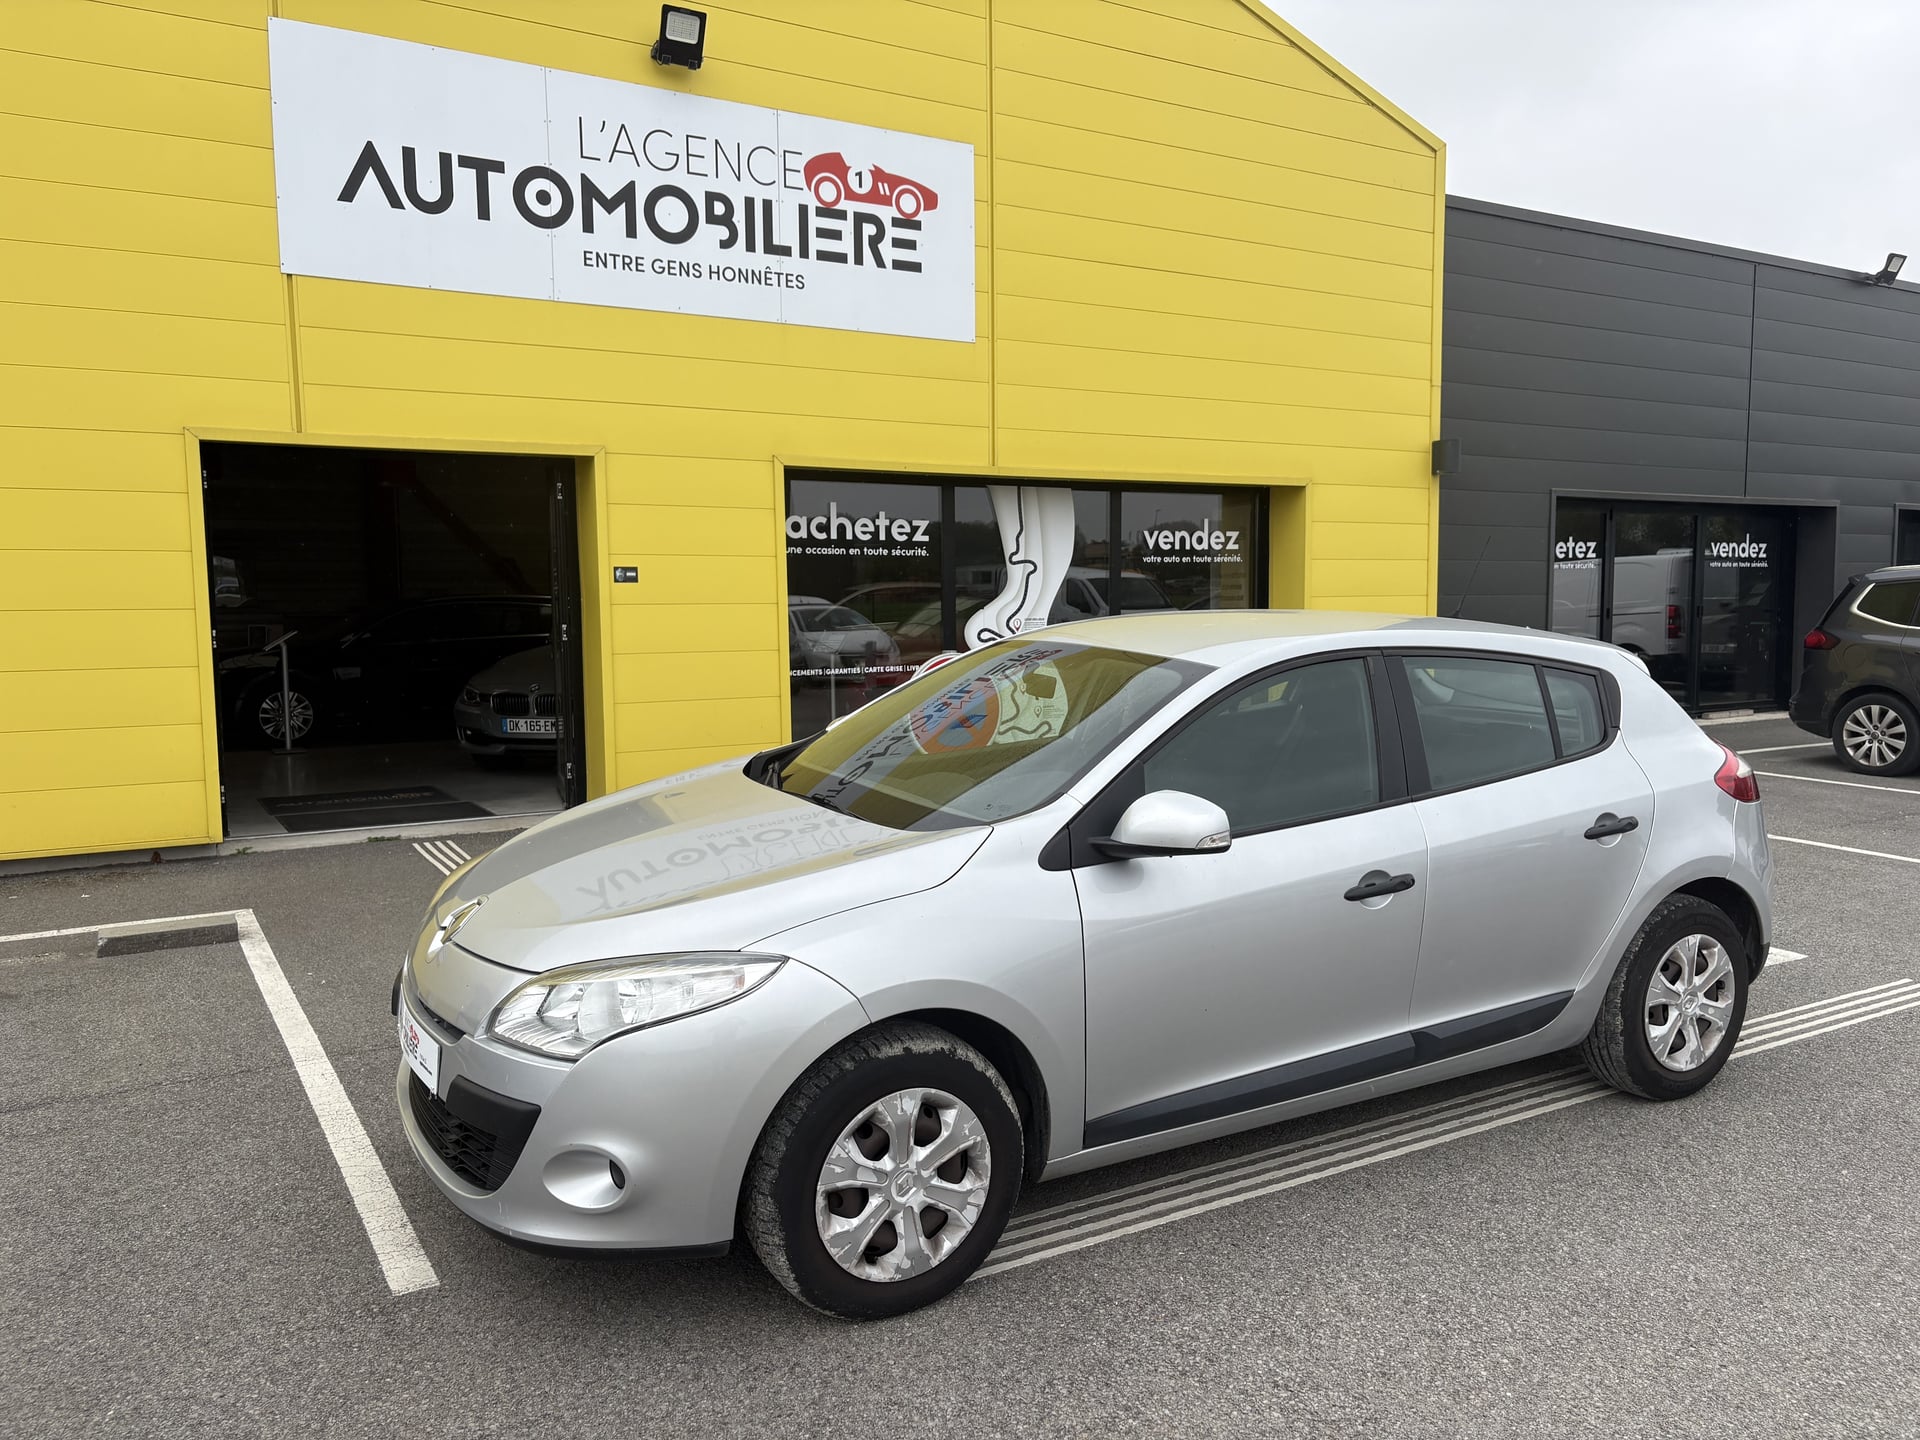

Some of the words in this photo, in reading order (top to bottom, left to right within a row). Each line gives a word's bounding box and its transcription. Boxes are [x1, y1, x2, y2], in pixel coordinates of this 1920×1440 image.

[583, 250, 645, 272] ENTRE
[651, 258, 702, 279] GENS
[708, 264, 805, 290] HONNÊTES
[785, 501, 930, 542] achetez
[1143, 518, 1240, 551] vendez
[1710, 532, 1768, 559] vendez
[805, 545, 847, 556] occasion
[849, 547, 861, 555] en
[863, 546, 889, 556] toute
[891, 545, 930, 557] sécurité.
[1142, 555, 1162, 563] votre
[1163, 554, 1181, 563] auto
[1193, 554, 1212, 563] toute
[1555, 536, 1597, 559] etez
[825, 667, 861, 676] GARANTIES
[864, 666, 885, 674] CARTE
[886, 664, 904, 673] GRISE
